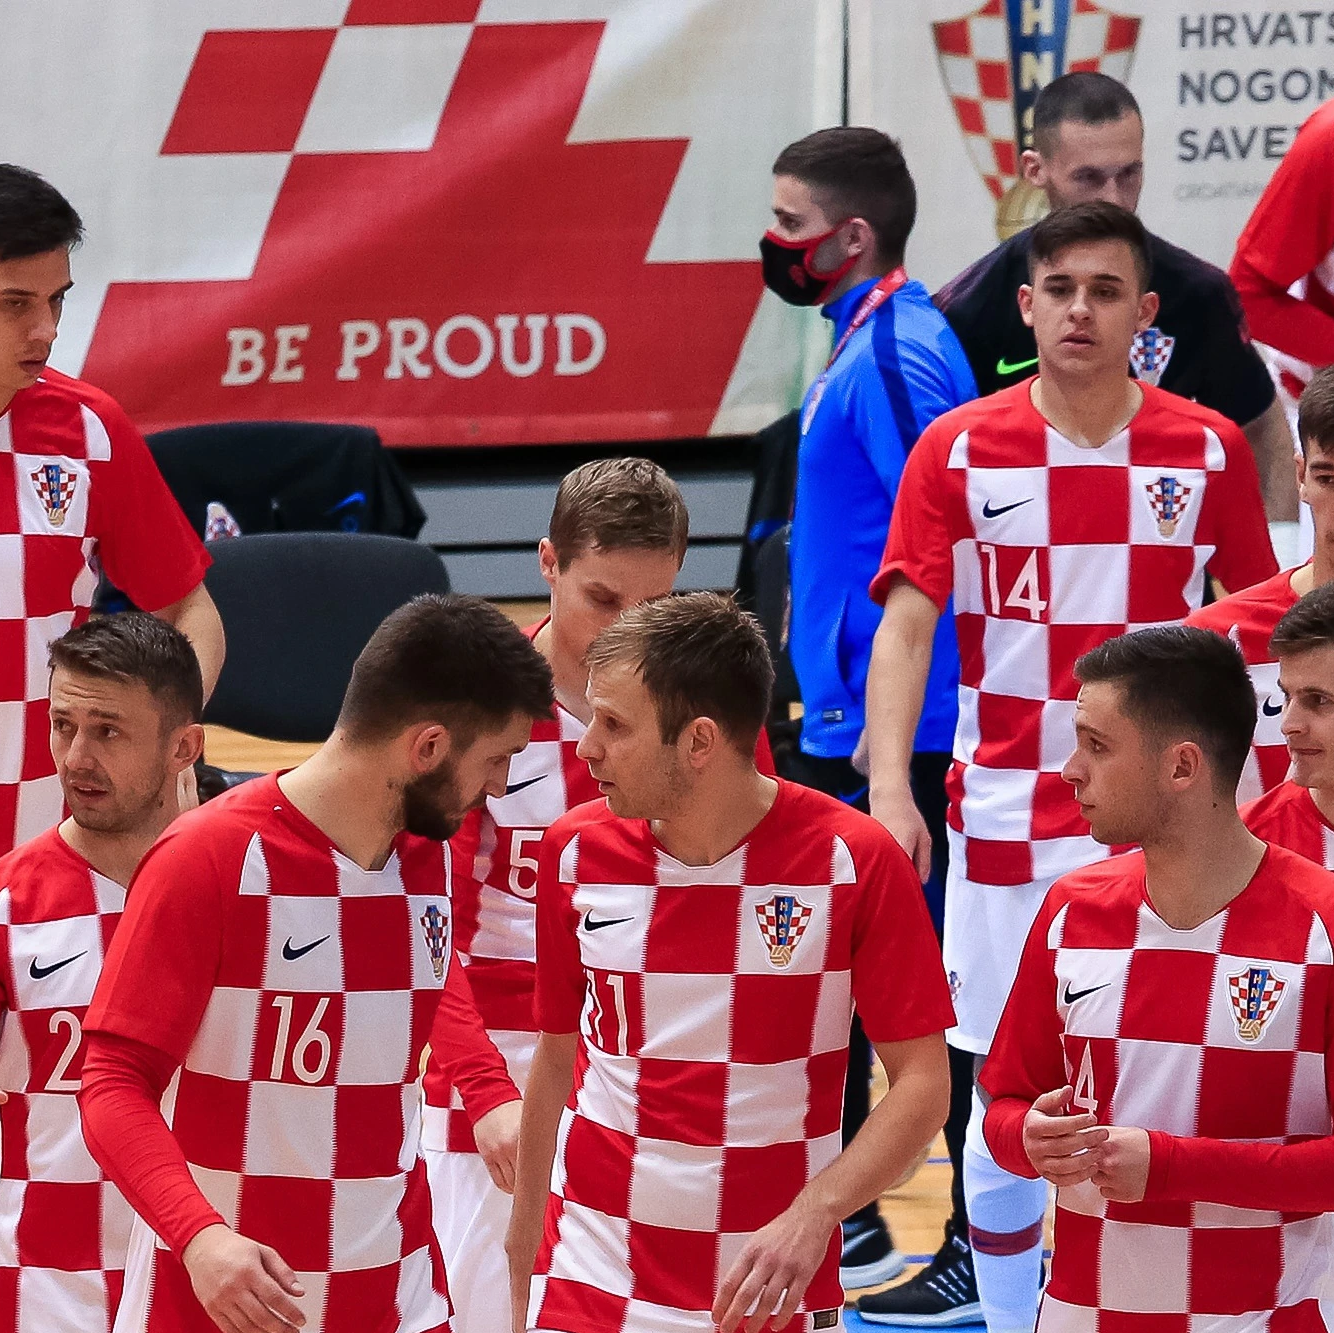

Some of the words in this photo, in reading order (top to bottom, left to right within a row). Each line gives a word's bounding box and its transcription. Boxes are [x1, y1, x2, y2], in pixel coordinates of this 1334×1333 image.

[1177, 126, 1301, 162] SAVE
[221, 325, 310, 387] BE
[336, 314, 607, 381] PROUD
[980, 543, 1048, 621] 14
[508, 829, 545, 899] 5
[41, 1010, 82, 1092] 2
[270, 995, 332, 1084] 16
